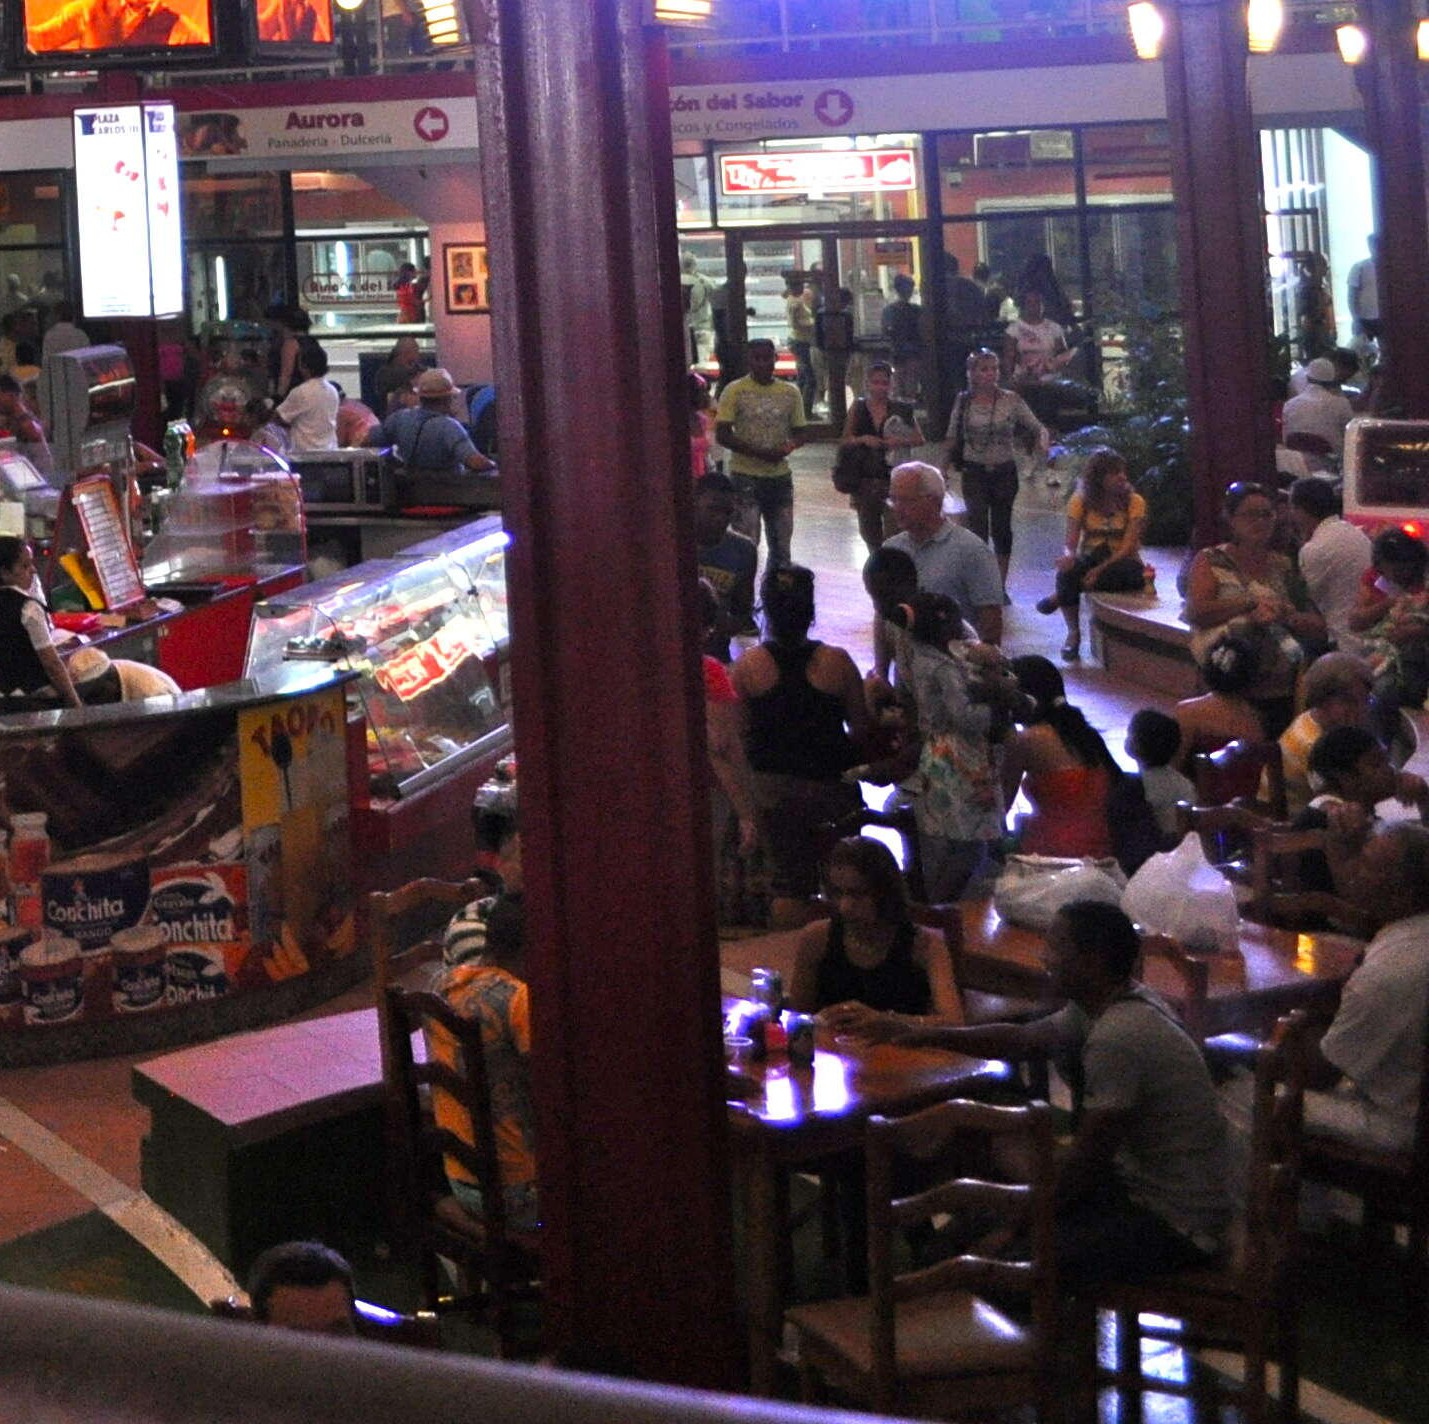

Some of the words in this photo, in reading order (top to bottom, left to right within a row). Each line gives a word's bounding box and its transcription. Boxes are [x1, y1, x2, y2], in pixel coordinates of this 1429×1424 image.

[706, 92, 737, 110] del
[743, 91, 804, 109] Sabor
[285, 111, 364, 130] Aurora
[716, 117, 799, 134] Congelados
[361, 279, 382, 292] del
[47, 897, 125, 923] Conchita
[158, 913, 233, 942] onchita
